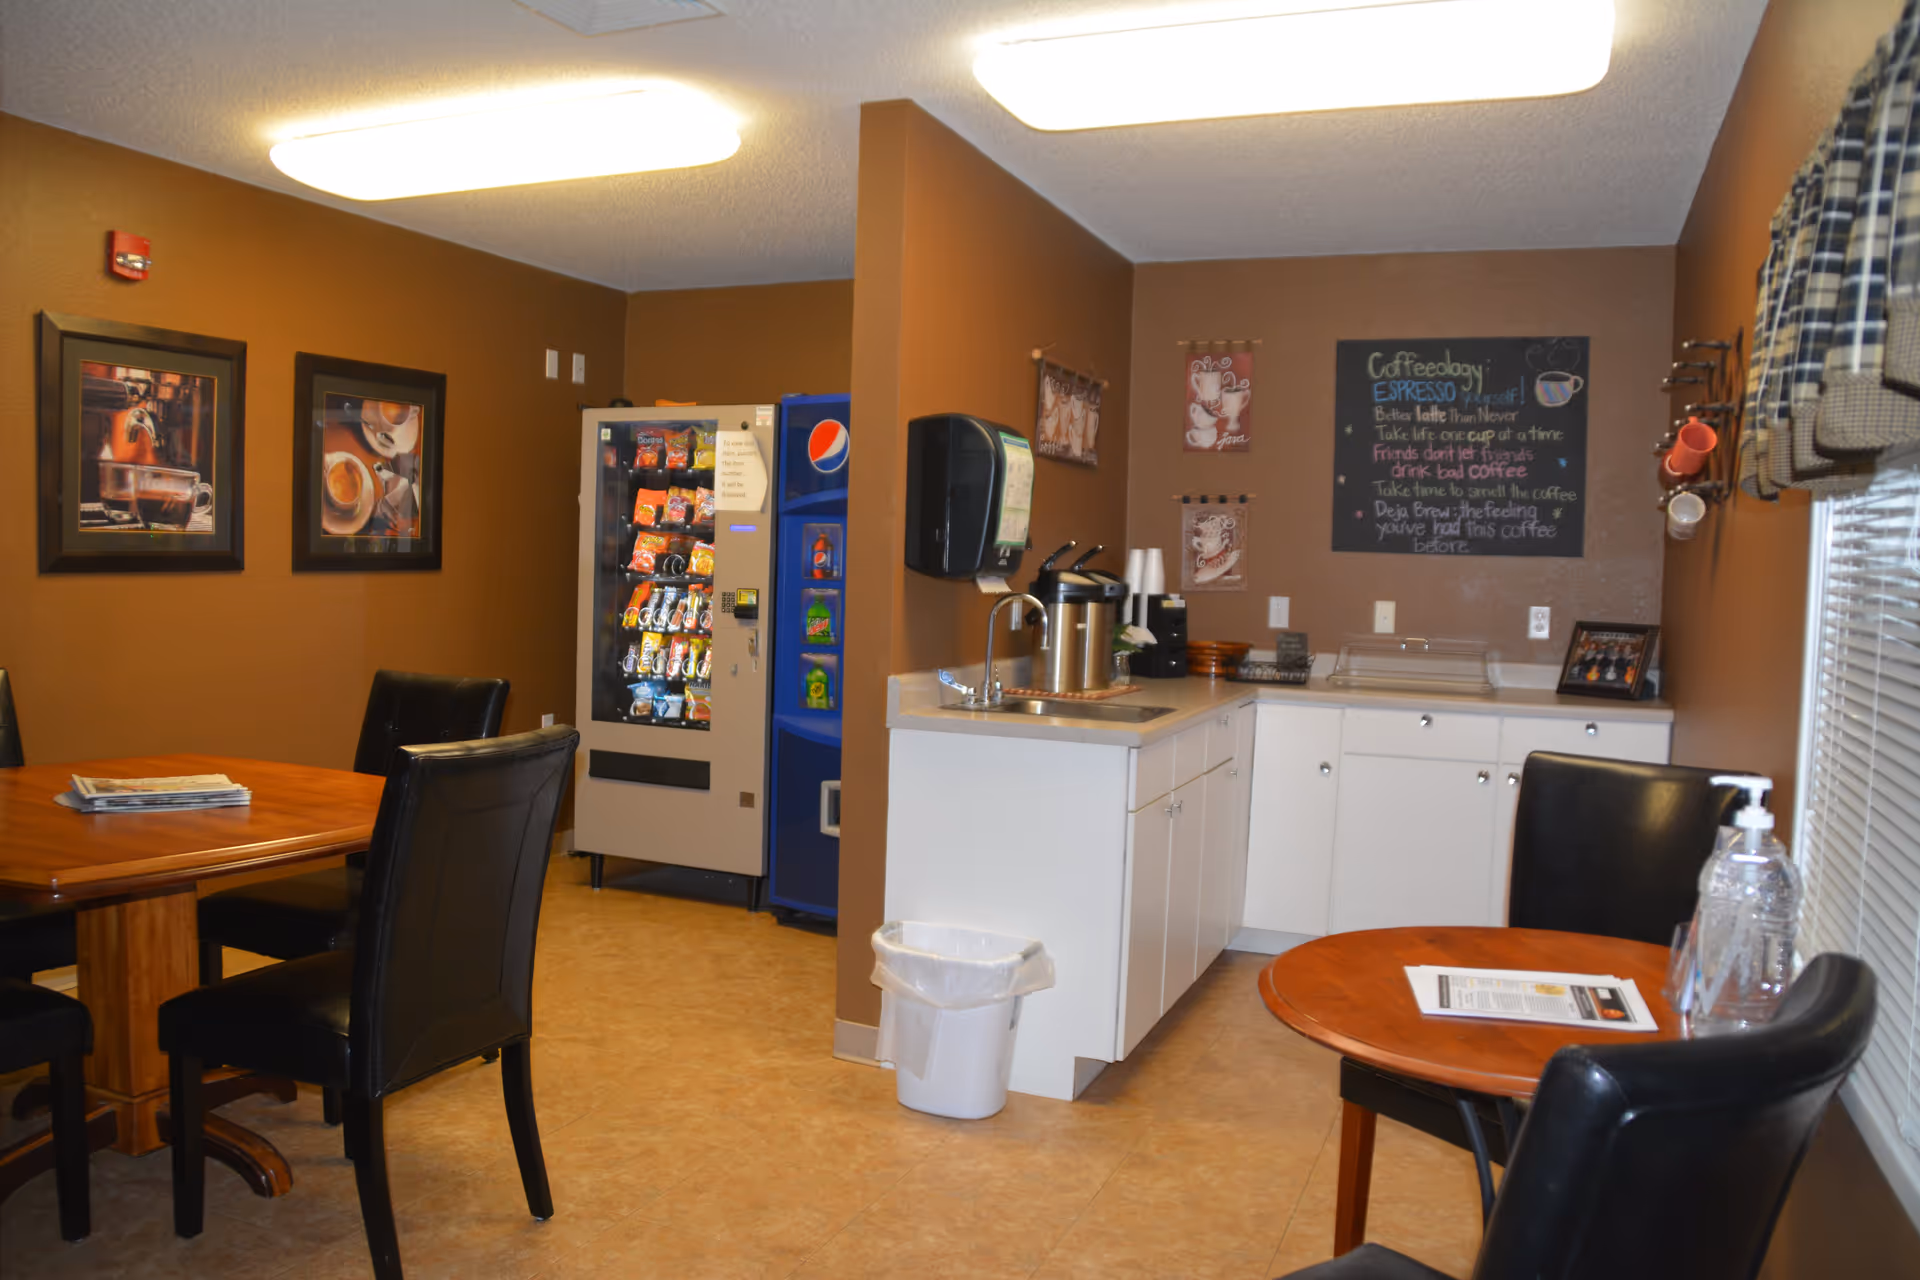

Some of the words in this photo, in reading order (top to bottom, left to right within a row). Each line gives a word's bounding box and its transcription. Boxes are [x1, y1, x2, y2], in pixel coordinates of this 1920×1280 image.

[1374, 380, 1456, 402] ESPRESSO
[1376, 406, 1412, 421] Better
[1415, 404, 1447, 423] latte
[1478, 405, 1518, 422] Never
[1375, 424, 1409, 441] Take
[1413, 426, 1436, 440] life
[1440, 431, 1465, 441] one
[1467, 430, 1495, 448] cup
[1498, 427, 1512, 441] at
[1517, 431, 1527, 440] a
[1528, 425, 1563, 441] time
[1374, 443, 1418, 461] Friends
[1457, 444, 1475, 460] let
[1392, 462, 1430, 479] drink
[1437, 463, 1464, 479] bad
[1468, 461, 1529, 479] coffee
[1372, 480, 1411, 497] Take
[1412, 481, 1447, 497] time
[1449, 482, 1463, 497] to
[1469, 484, 1506, 498] smell
[1533, 486, 1577, 501] coffee
[1375, 500, 1409, 520] Deja
[1460, 500, 1483, 519] the
[1484, 500, 1537, 521] feeling
[1433, 517, 1461, 536] had
[1465, 520, 1496, 538] this
[1501, 520, 1557, 538] coffee
